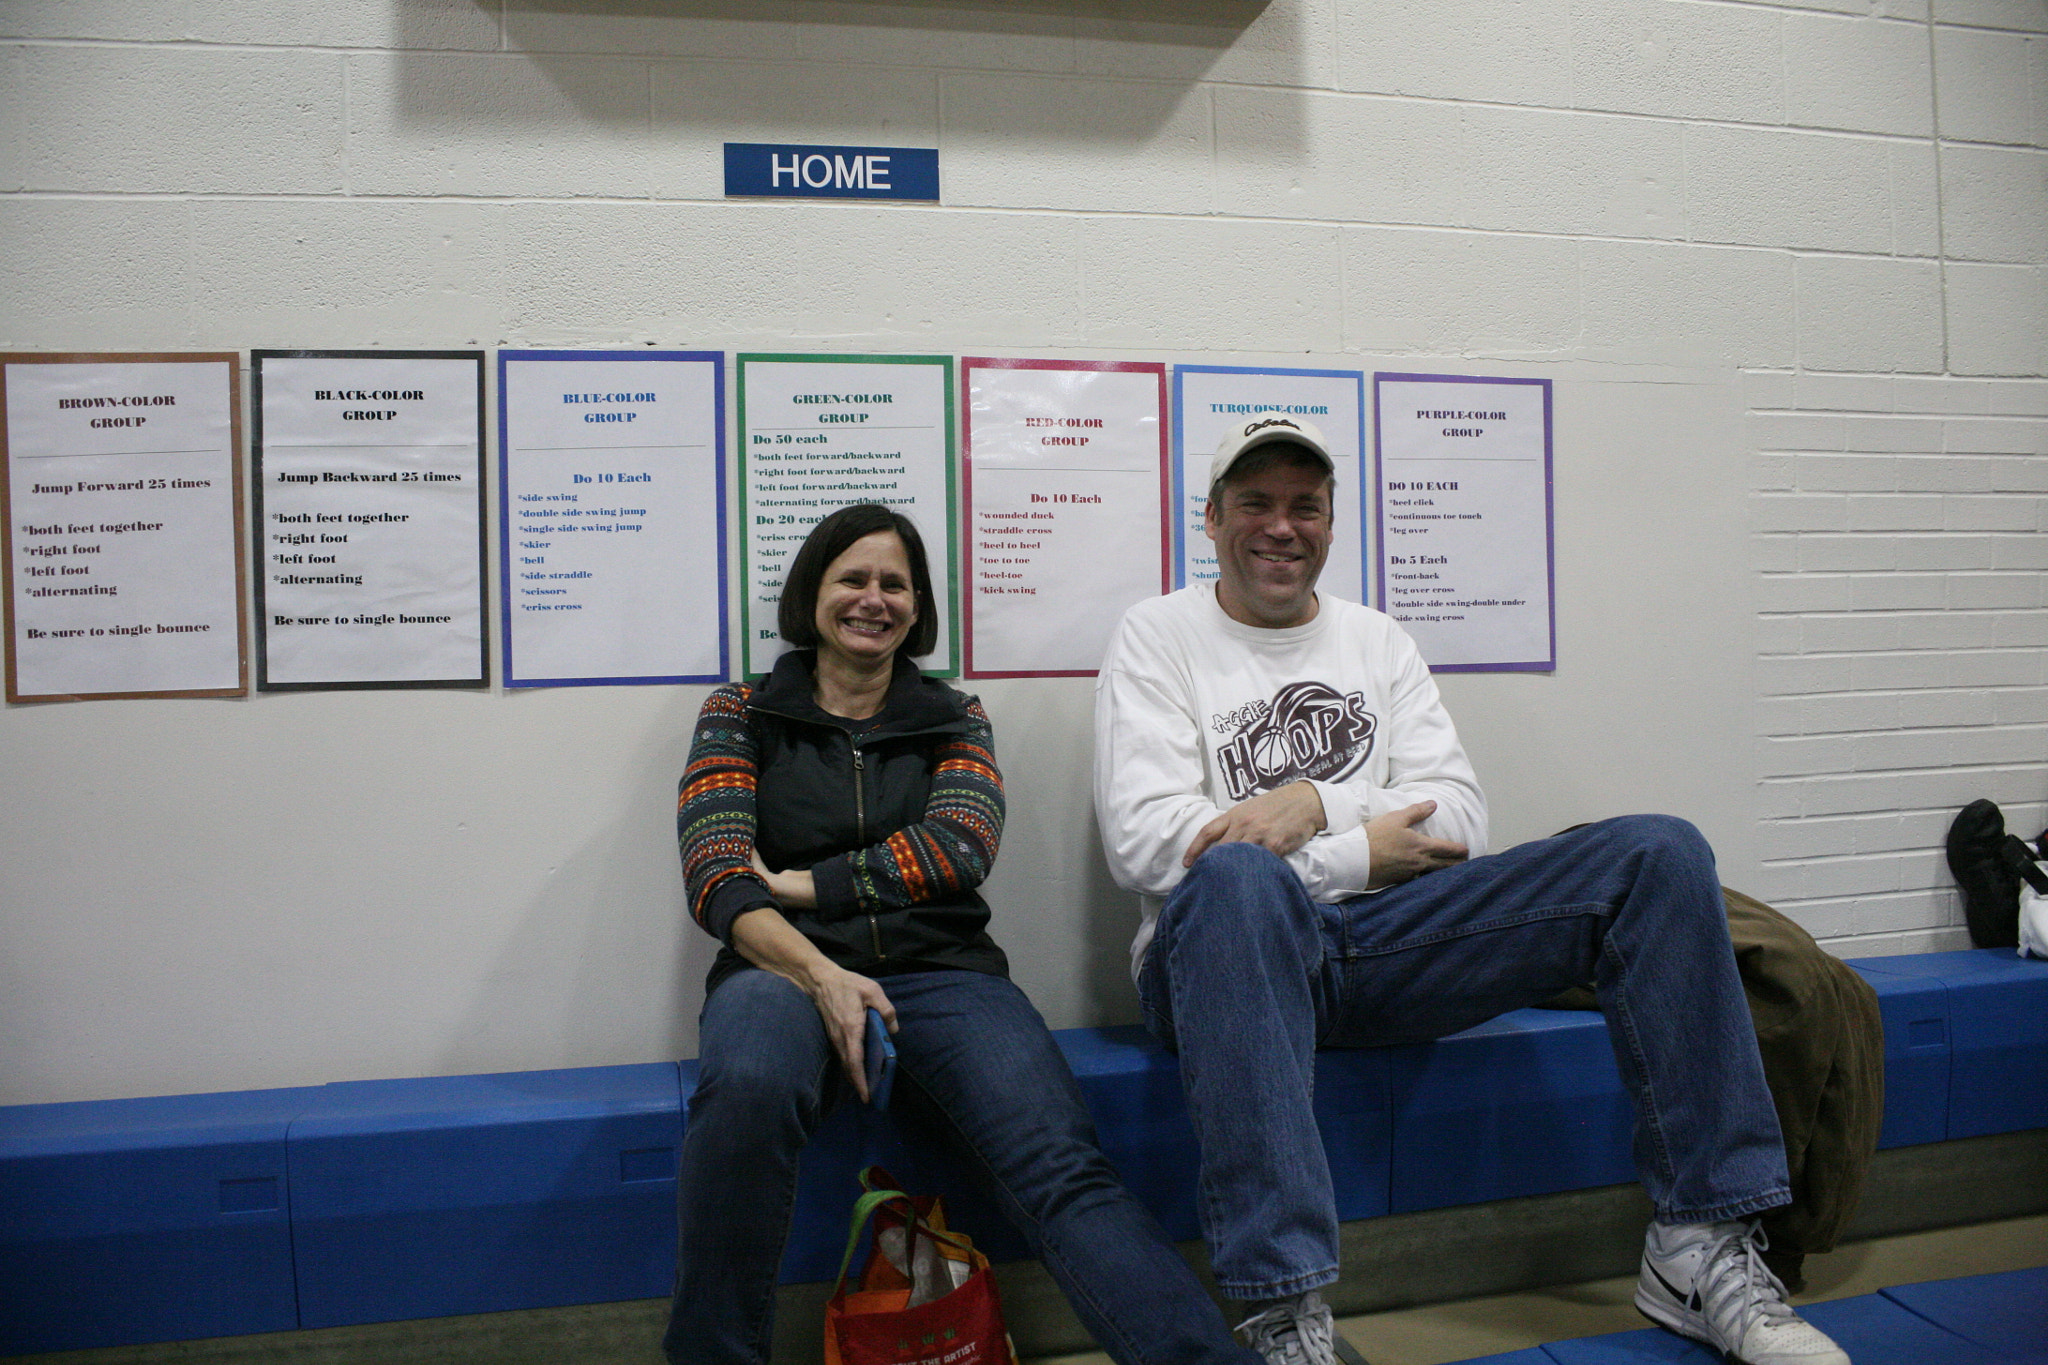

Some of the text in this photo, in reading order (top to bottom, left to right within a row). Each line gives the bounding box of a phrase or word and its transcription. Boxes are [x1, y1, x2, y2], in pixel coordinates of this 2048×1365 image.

[772, 153, 892, 190] HOME
[314, 390, 424, 401] BLACK-COLOR
[563, 392, 656, 404] BLUE-COLOR
[792, 393, 893, 404] GREEN-COLOR
[59, 395, 176, 409] BROWN-COLOR
[1210, 403, 1328, 415] TURQUOISE-COLOR
[342, 410, 397, 421] GROUP
[584, 412, 637, 423] GROUP
[818, 413, 869, 423] GROUP
[1417, 410, 1507, 421] PURPLE-COLOR
[90, 417, 146, 429] GROUP
[1025, 417, 1103, 428] RED-COLOR
[1442, 428, 1484, 438] GROUP
[753, 434, 828, 445] Do 50 each
[1041, 436, 1089, 446] GROUP
[784, 453, 803, 461] feet
[806, 451, 901, 460] forward/backward
[787, 468, 807, 476] foot
[810, 466, 905, 475] forward/backward
[277, 471, 461, 485] Jump Backward 25 times
[573, 472, 652, 484] Do 10 Each
[32, 478, 211, 496] Jump Forward 25 times
[779, 483, 799, 491] foot
[802, 481, 897, 491] forward/backward
[1389, 482, 1458, 491] DO 10 EACH
[546, 493, 578, 503] swing
[820, 497, 915, 505] forward/backward
[1031, 493, 1102, 504] Do 10 Each
[561, 508, 583, 517] side
[585, 508, 617, 517] swing
[619, 507, 647, 517] jump
[316, 513, 343, 523] feet
[347, 512, 409, 525] together
[756, 514, 826, 525] Do 20 eac
[67, 523, 94, 534] feet
[99, 521, 163, 535] together
[557, 524, 579, 532] side
[581, 523, 613, 533] swing
[615, 523, 642, 533] jump
[320, 533, 348, 543] foot
[72, 544, 101, 554] foot
[1020, 541, 1040, 549] heel
[308, 553, 336, 564] foot
[1391, 555, 1448, 565] Do 5 Each
[61, 565, 89, 576] foot
[549, 571, 593, 579] straddle
[1007, 586, 1036, 595] swing
[1446, 599, 1500, 608] swing-double
[273, 613, 451, 626] Be sure to single bounce
[1415, 614, 1440, 622] swing
[27, 623, 210, 639] Be sure to single bounce
[759, 629, 777, 640] Be
[1212, 700, 1273, 734] AGGIE
[943, 1341, 976, 1363] ARTIST
